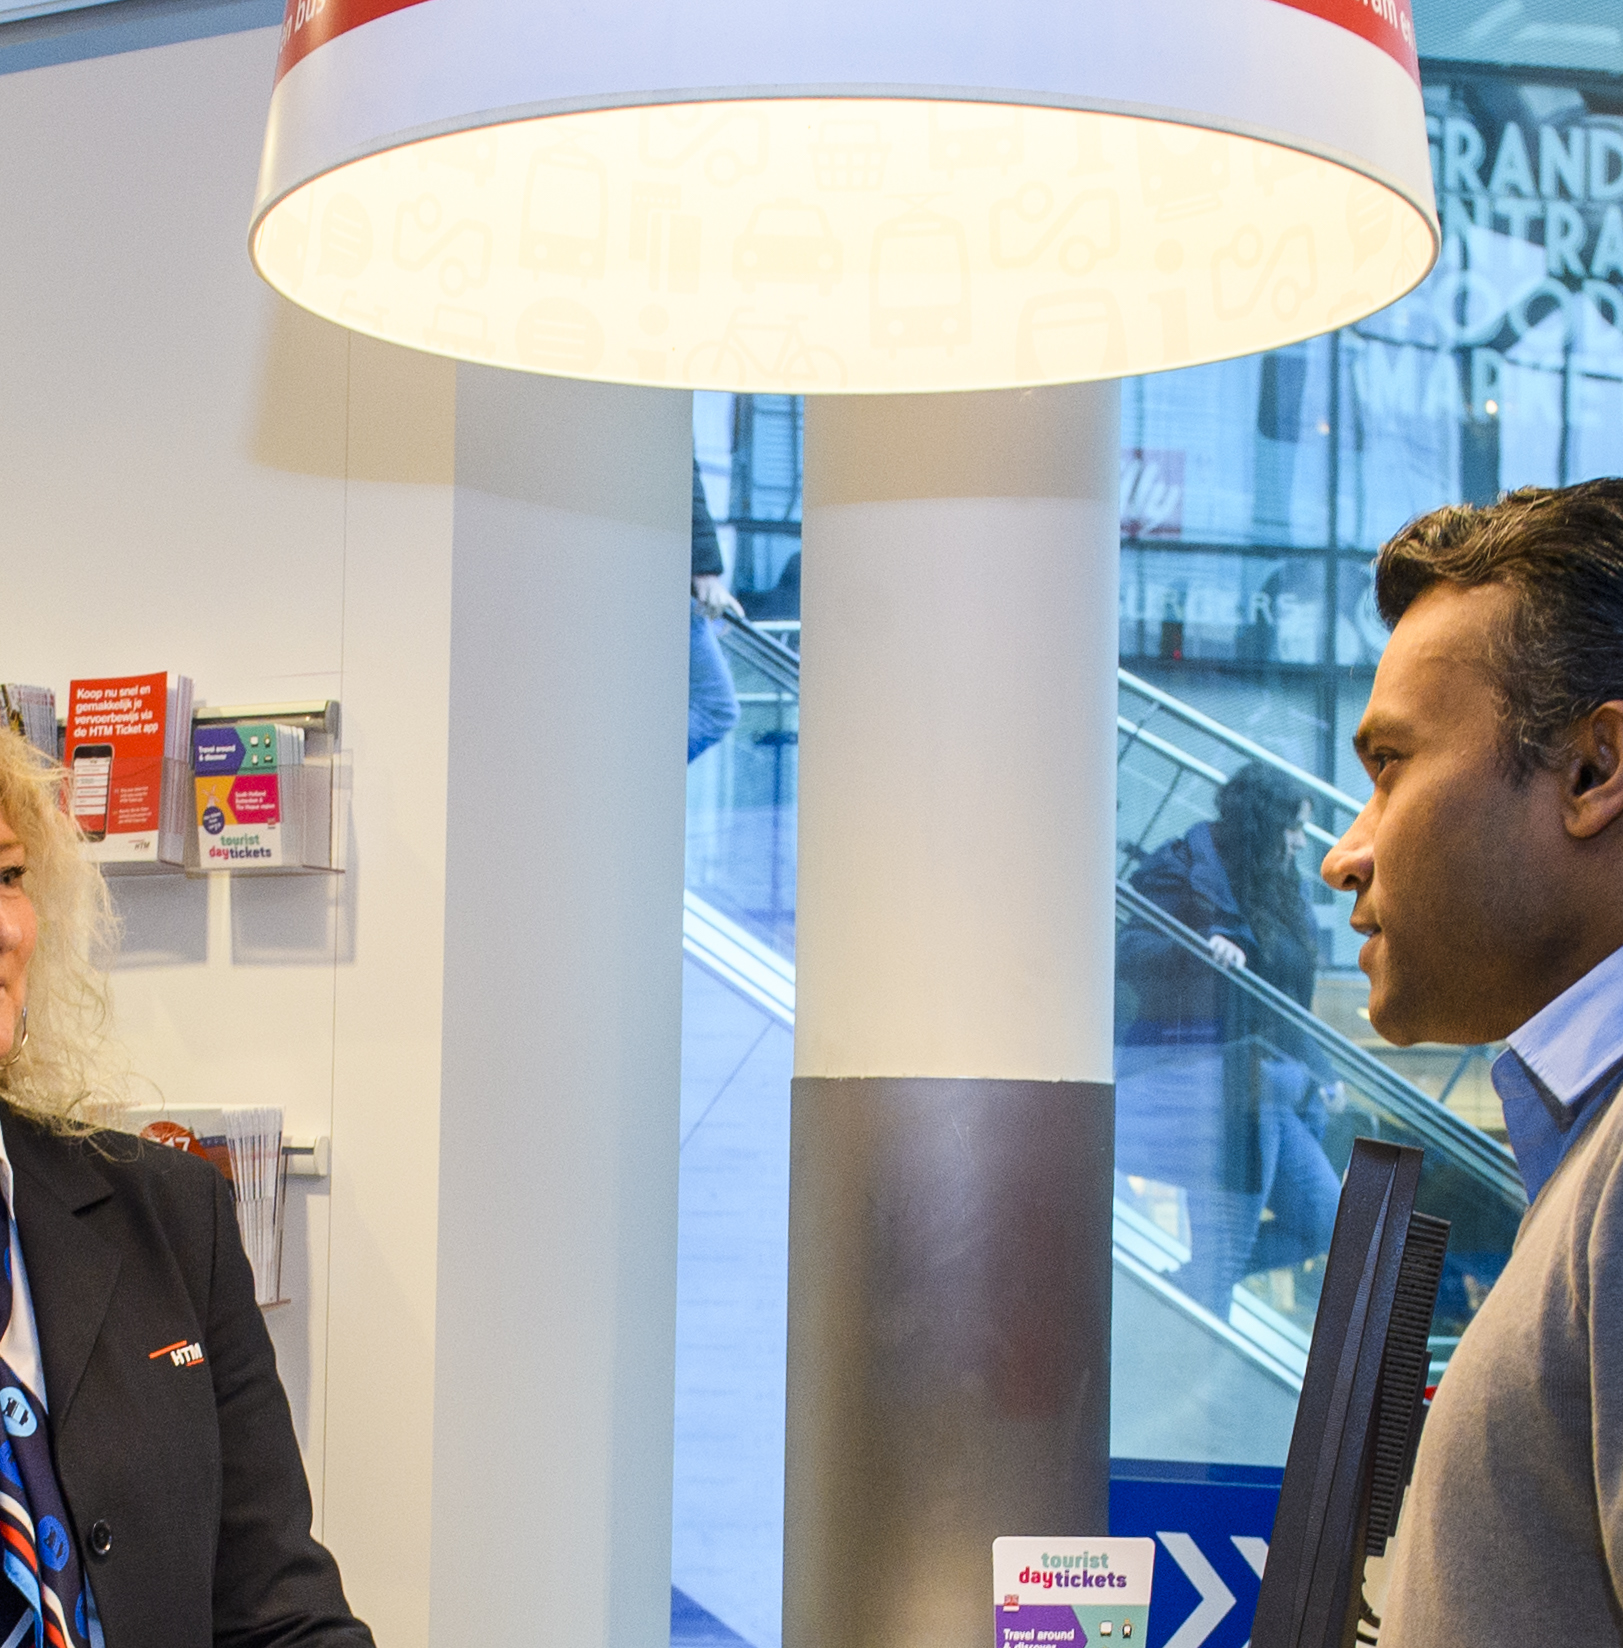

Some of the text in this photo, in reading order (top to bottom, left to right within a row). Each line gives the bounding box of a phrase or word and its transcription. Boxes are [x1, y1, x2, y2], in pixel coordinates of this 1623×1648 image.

[76, 684, 151, 699] Koop nu snel en
[75, 698, 143, 714] gemakkelijk je
[74, 709, 153, 725] vervoerbewijs via
[73, 722, 159, 738] de HTM Ticket app
[220, 832, 260, 846] tourist
[208, 845, 272, 861] daytickets
[170, 1342, 203, 1367] HTM
[1040, 1551, 1109, 1569] tourist
[1018, 1566, 1127, 1589] daytickets
[1003, 1628, 1075, 1641] Travel around
